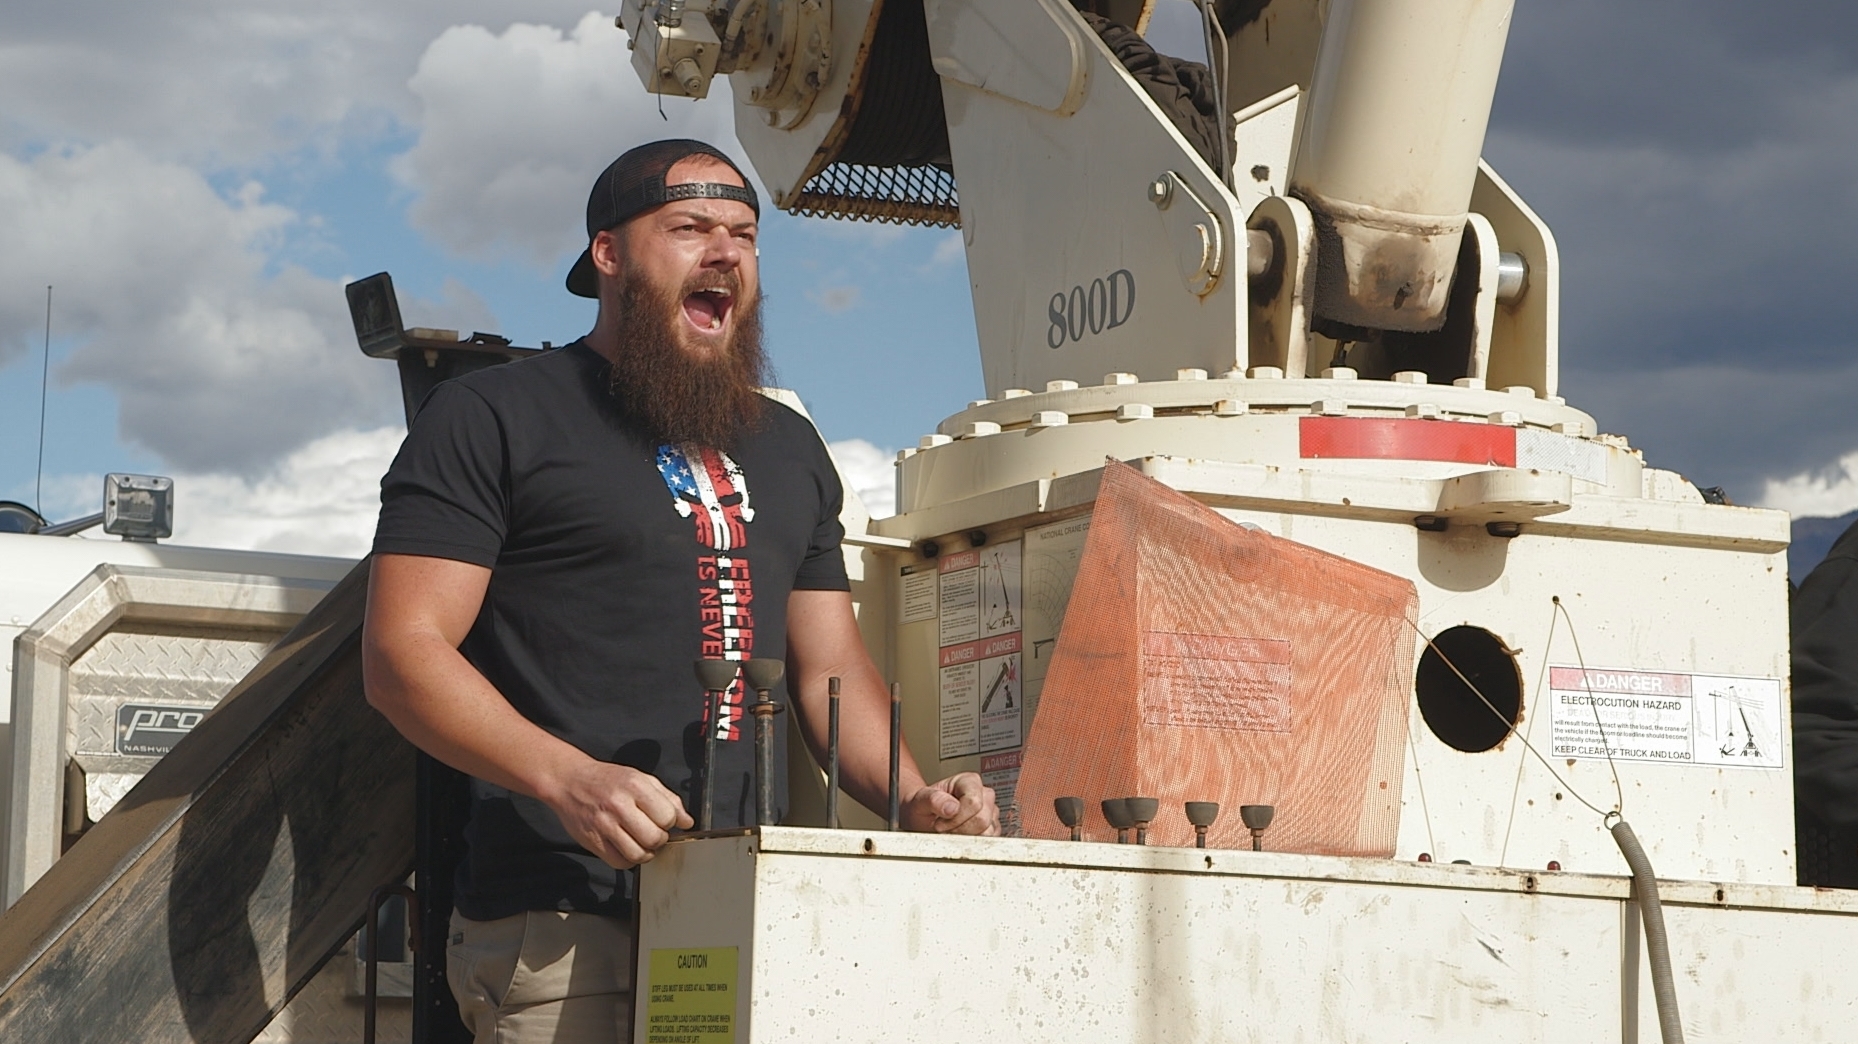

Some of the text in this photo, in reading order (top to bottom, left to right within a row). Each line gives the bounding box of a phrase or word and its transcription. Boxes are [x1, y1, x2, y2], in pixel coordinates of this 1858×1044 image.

[1047, 269, 1135, 349] 800D
[1040, 529, 1064, 540] NATIONAL
[1064, 523, 1082, 535] CRANE
[951, 553, 974, 567] DANGER
[697, 555, 724, 660] IS NEVE
[992, 638, 1016, 653] DANGER
[950, 647, 974, 661] DANGER
[1596, 674, 1662, 691] DANGER
[1561, 695, 1681, 711] ELECTROCUTION HAZARD
[124, 745, 172, 754] NASHVIL
[1554, 745, 1691, 760] KEEP CLEAR OF TRUCK AND LOAD
[990, 755, 1017, 768] DANGER
[677, 954, 708, 969] CAUTION
